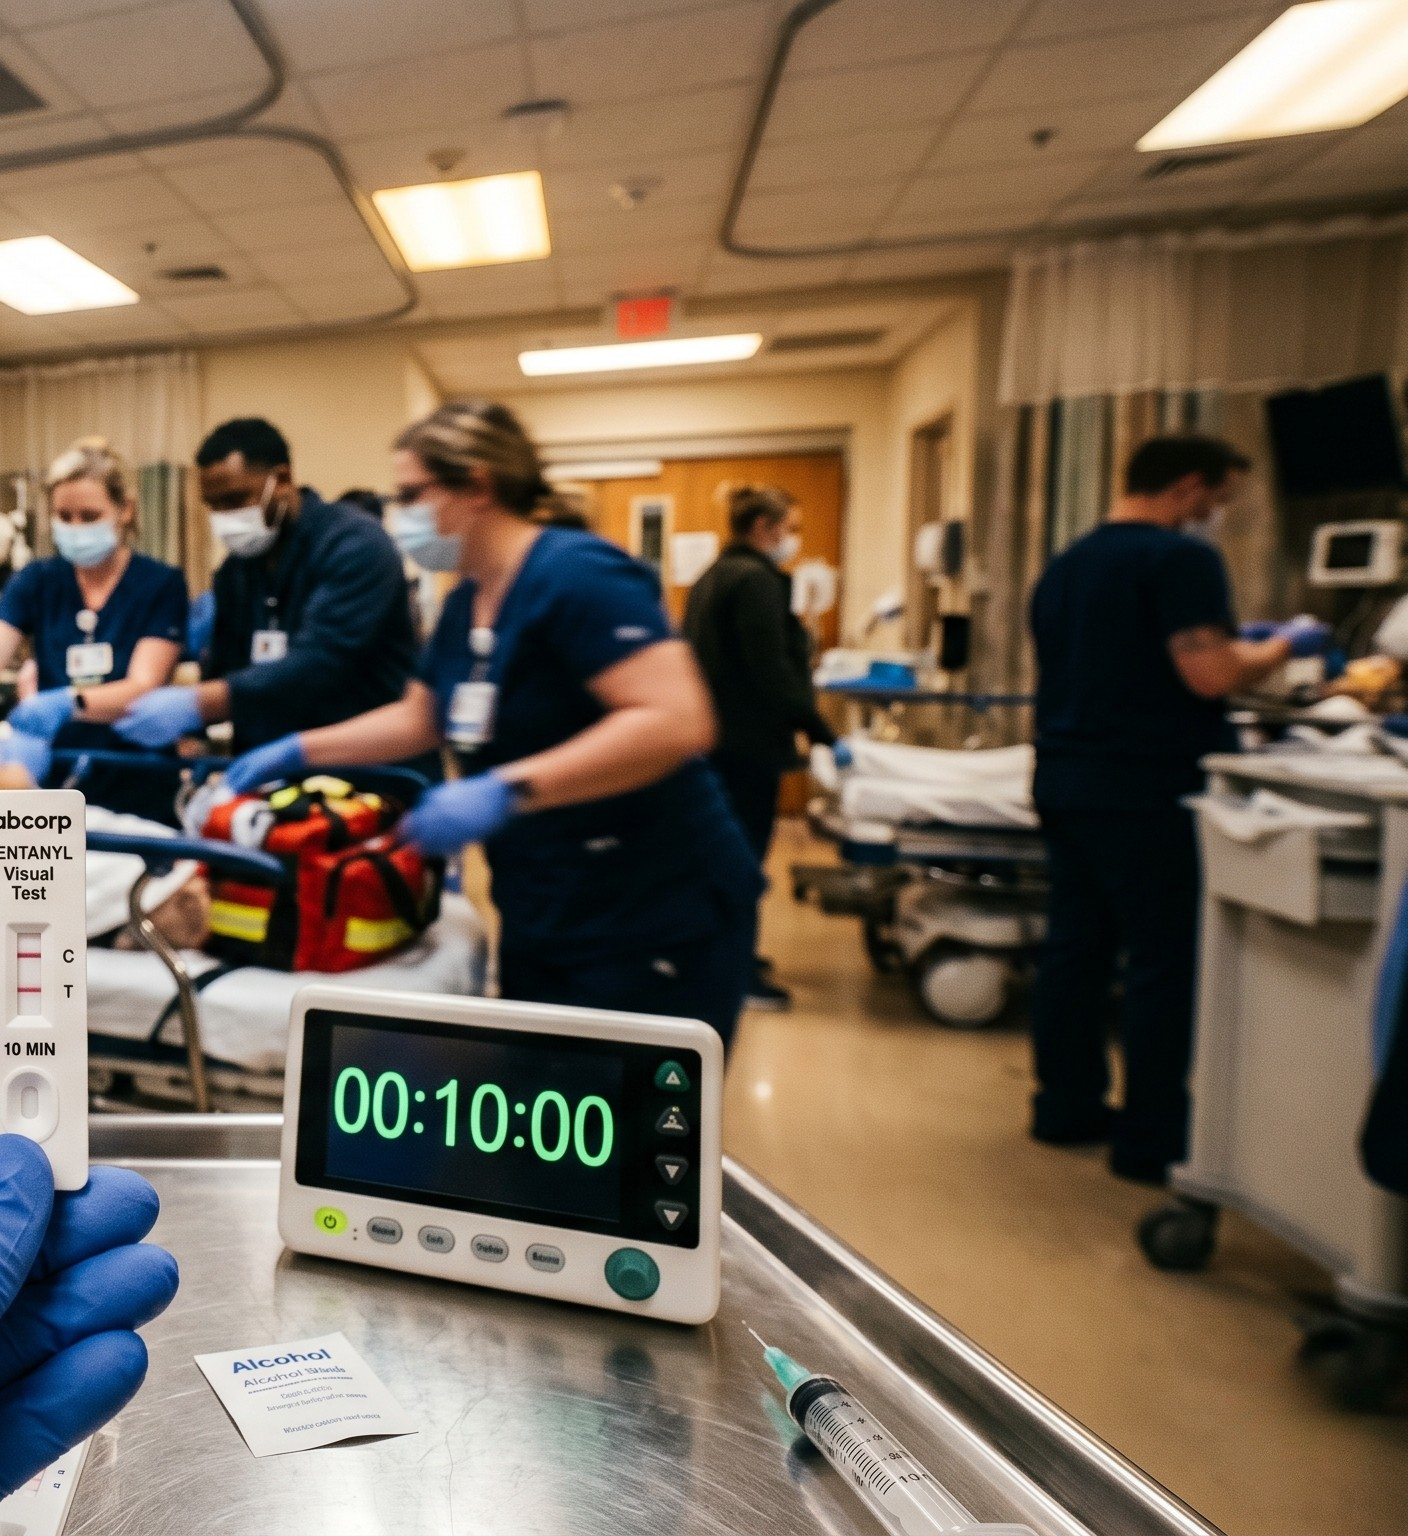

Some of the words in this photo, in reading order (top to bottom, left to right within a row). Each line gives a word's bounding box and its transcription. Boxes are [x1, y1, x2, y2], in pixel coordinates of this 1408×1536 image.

[3, 866, 54, 881] Visual
[11, 885, 47, 900] Test
[62, 949, 75, 963] C
[63, 984, 74, 998] T
[4, 1042, 21, 1056] 10
[26, 1042, 56, 1056] MIN
[334, 1066, 614, 1167] 00:10:00
[232, 1348, 332, 1374] Alcohol
